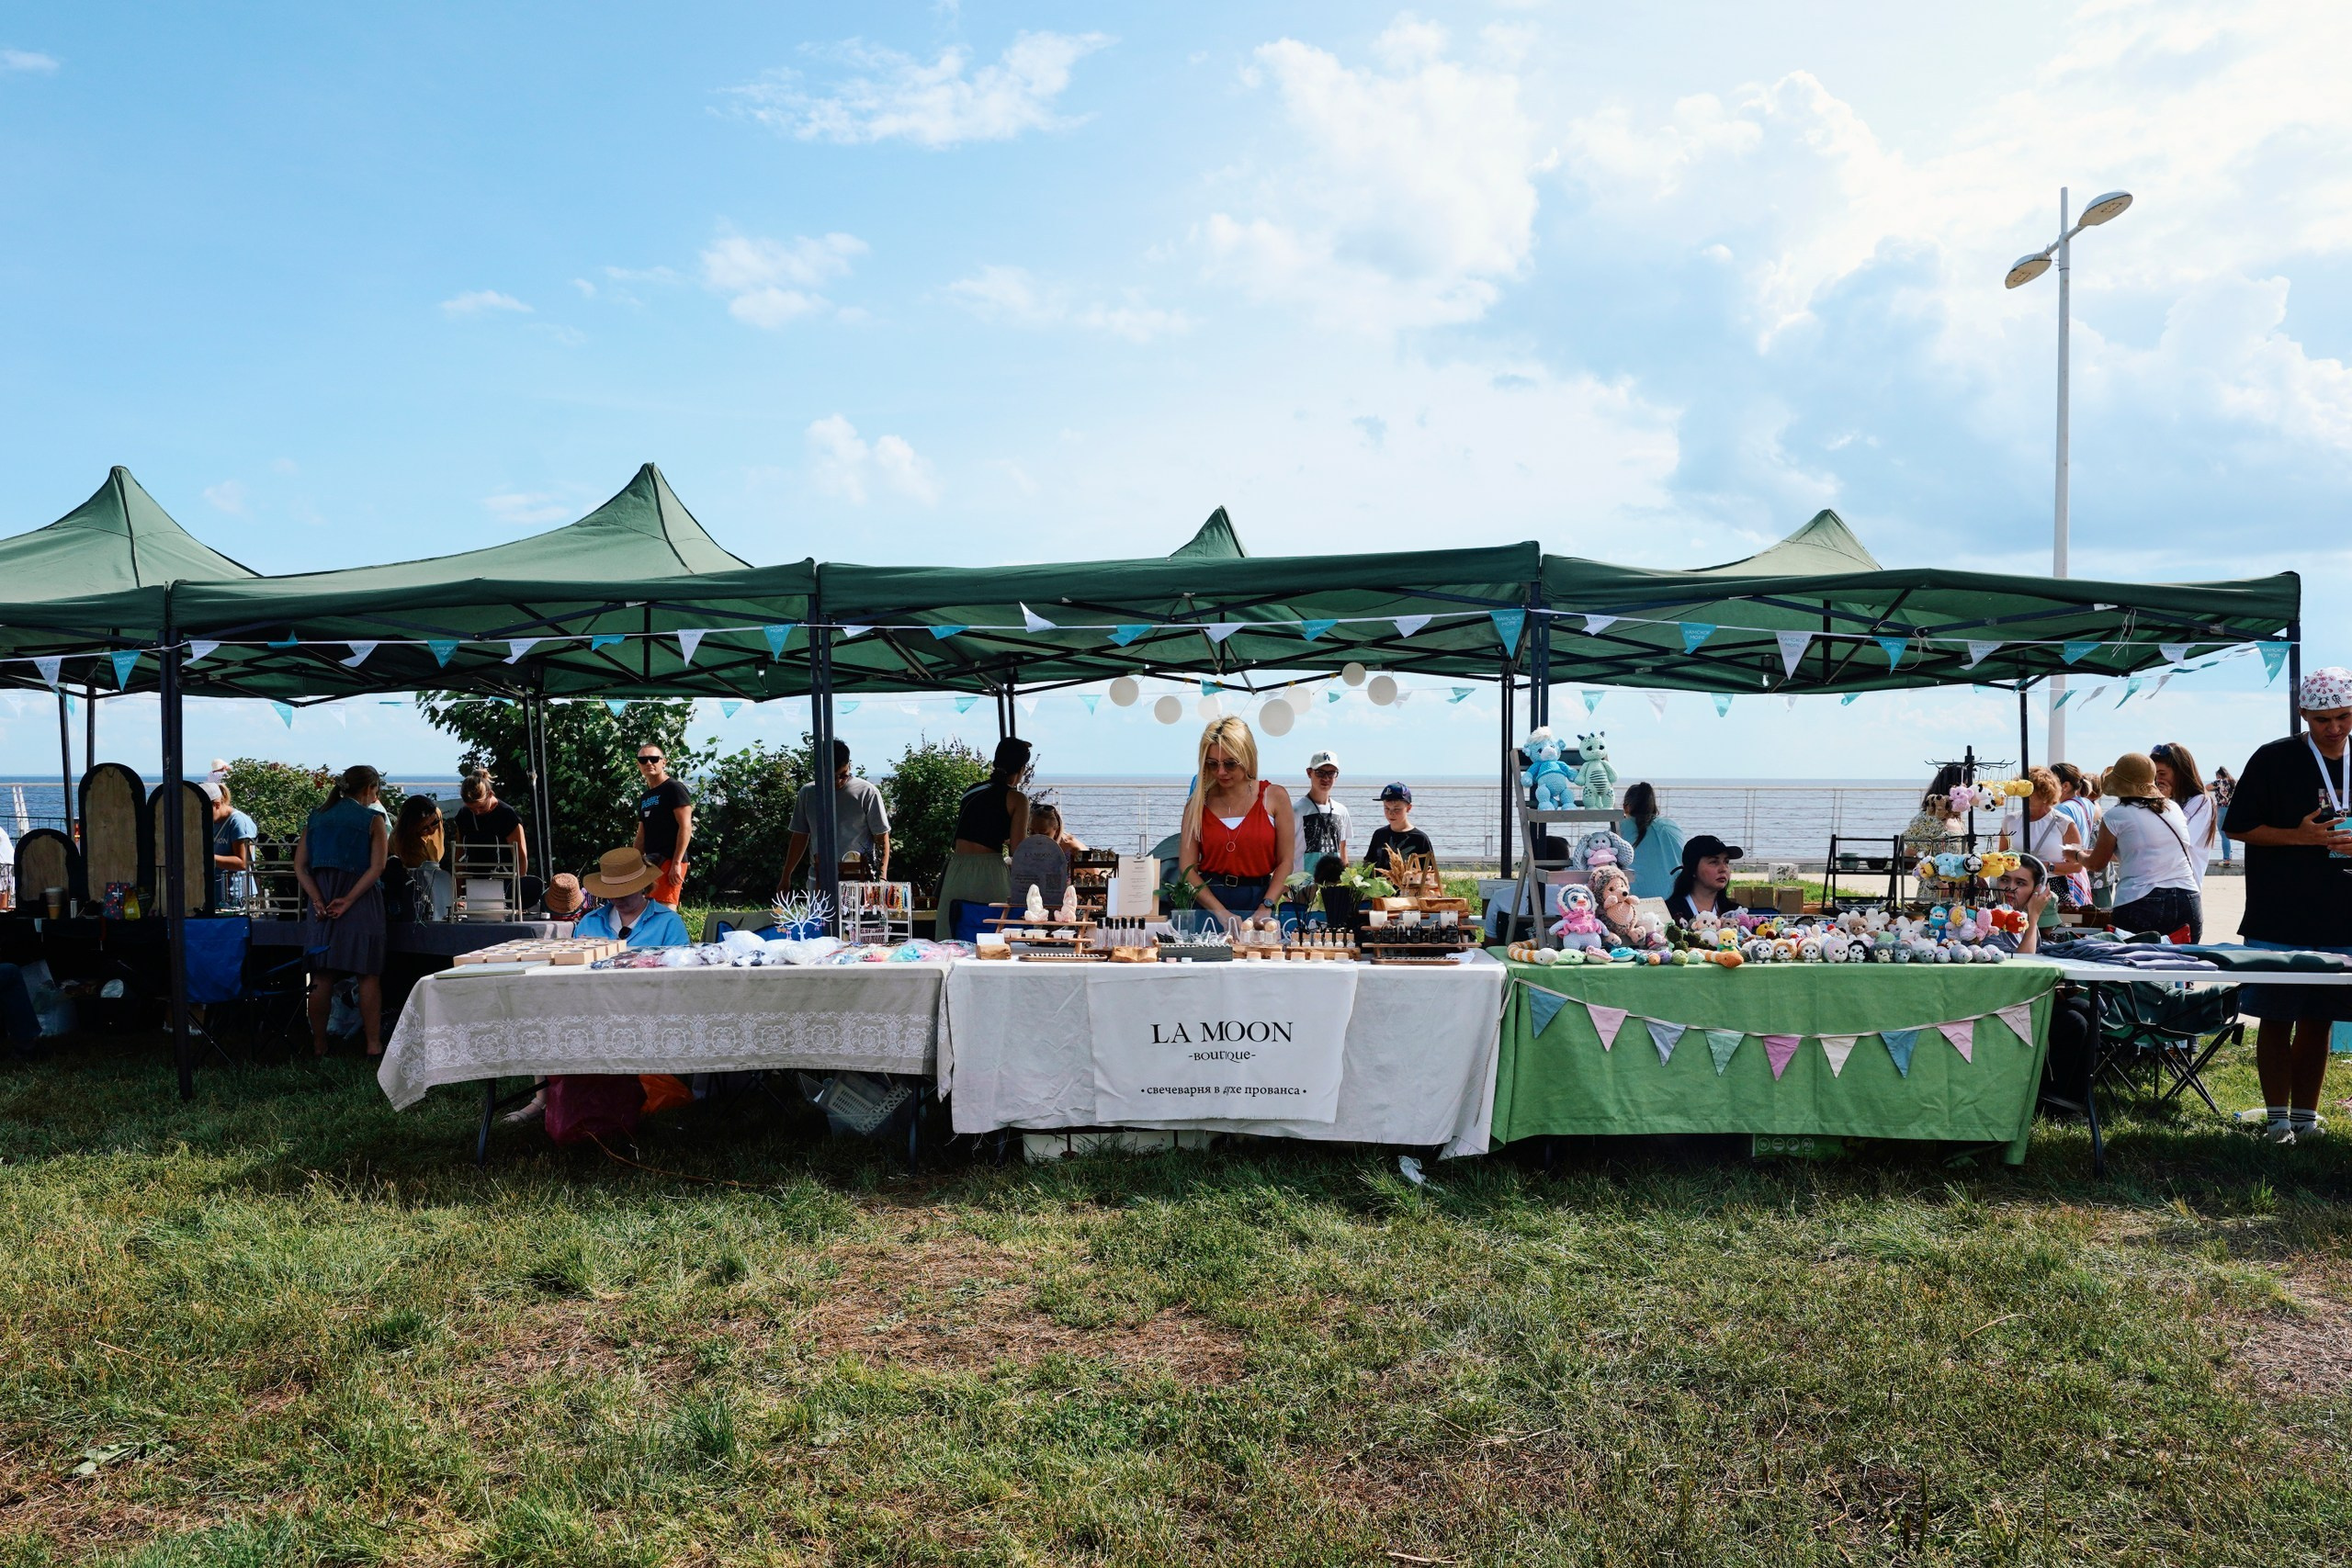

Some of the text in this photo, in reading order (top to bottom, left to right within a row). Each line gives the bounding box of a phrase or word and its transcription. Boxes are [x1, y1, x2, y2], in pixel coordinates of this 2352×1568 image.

[1150, 1021, 1293, 1043] LA MOON
[1147, 1087, 1211, 1097] свечеварня
[1245, 1087, 1300, 1097] прованса
